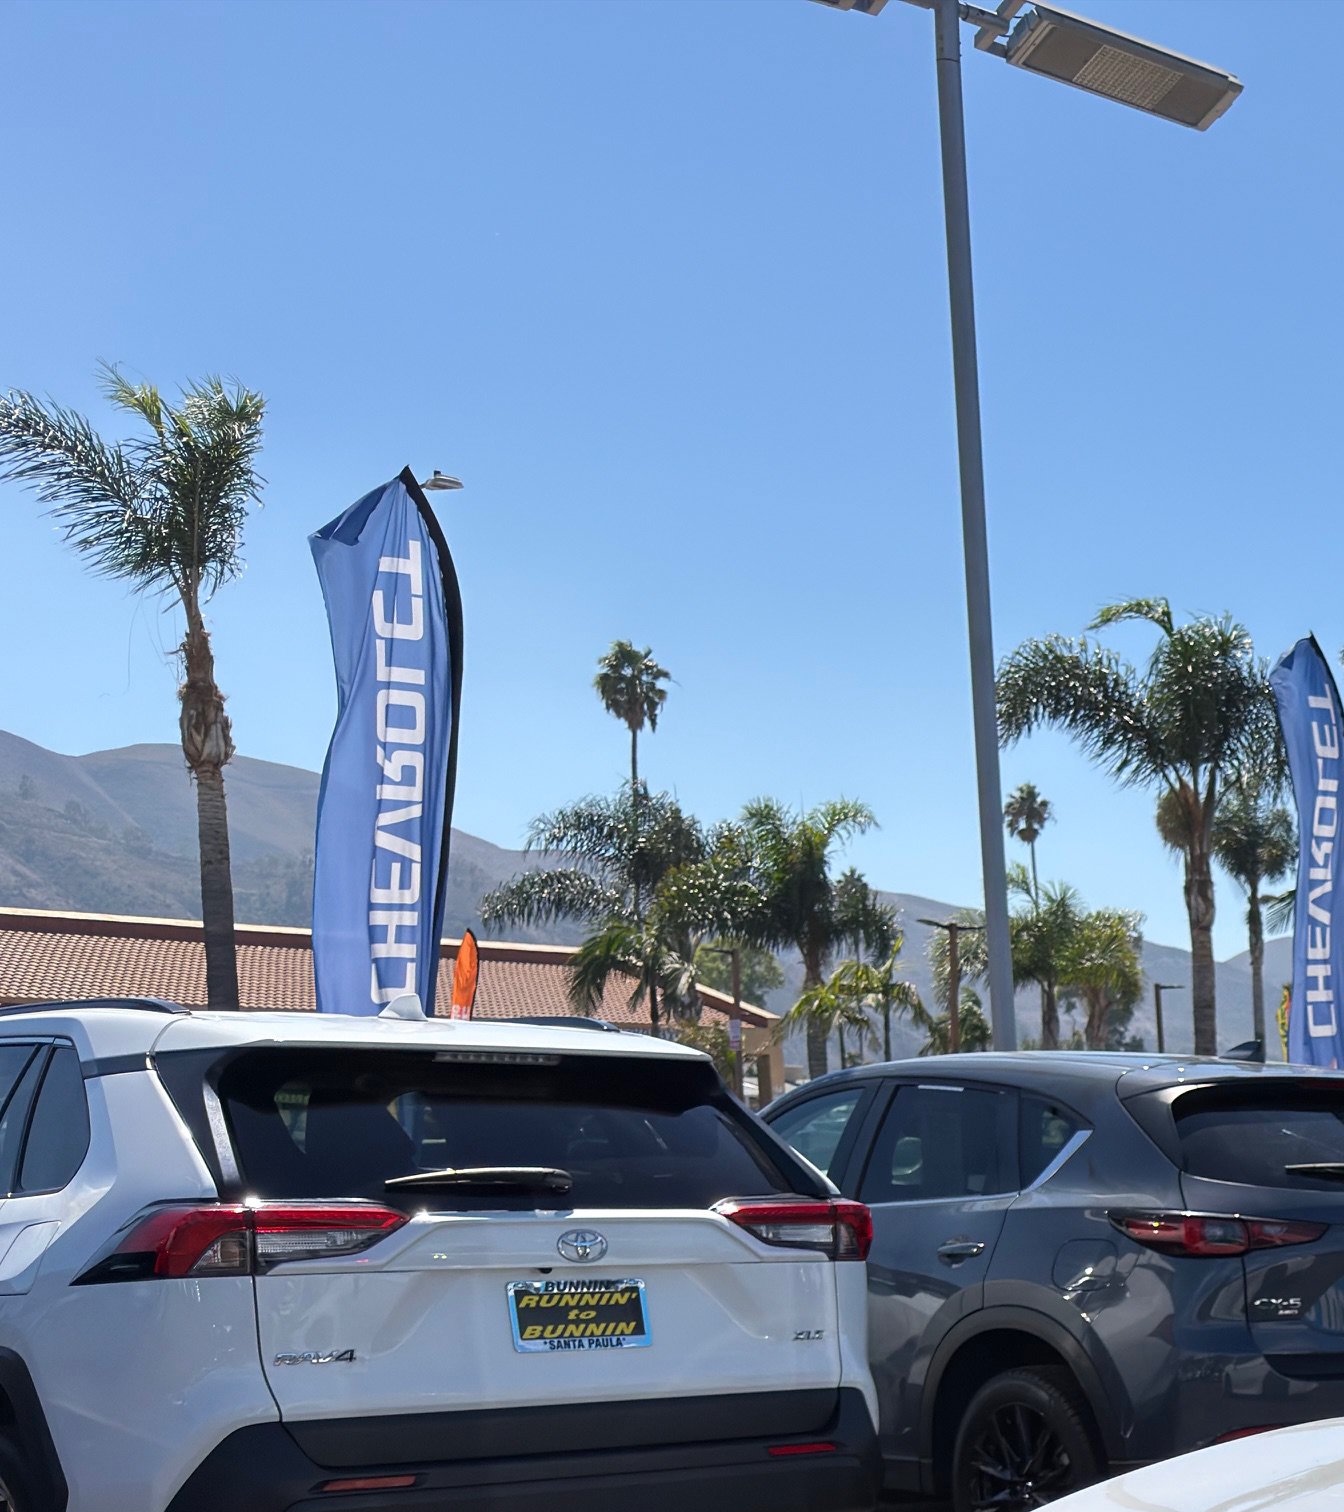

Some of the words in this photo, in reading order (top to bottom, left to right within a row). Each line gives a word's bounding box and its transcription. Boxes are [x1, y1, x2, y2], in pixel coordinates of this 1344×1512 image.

[544, 1280, 611, 1293] BUNNIN
[519, 1292, 638, 1309] RUNNIN'
[1253, 1297, 1302, 1310] CX-5
[567, 1309, 597, 1320] to
[521, 1321, 637, 1340] BUNNIN
[273, 1349, 357, 1367] RAV4
